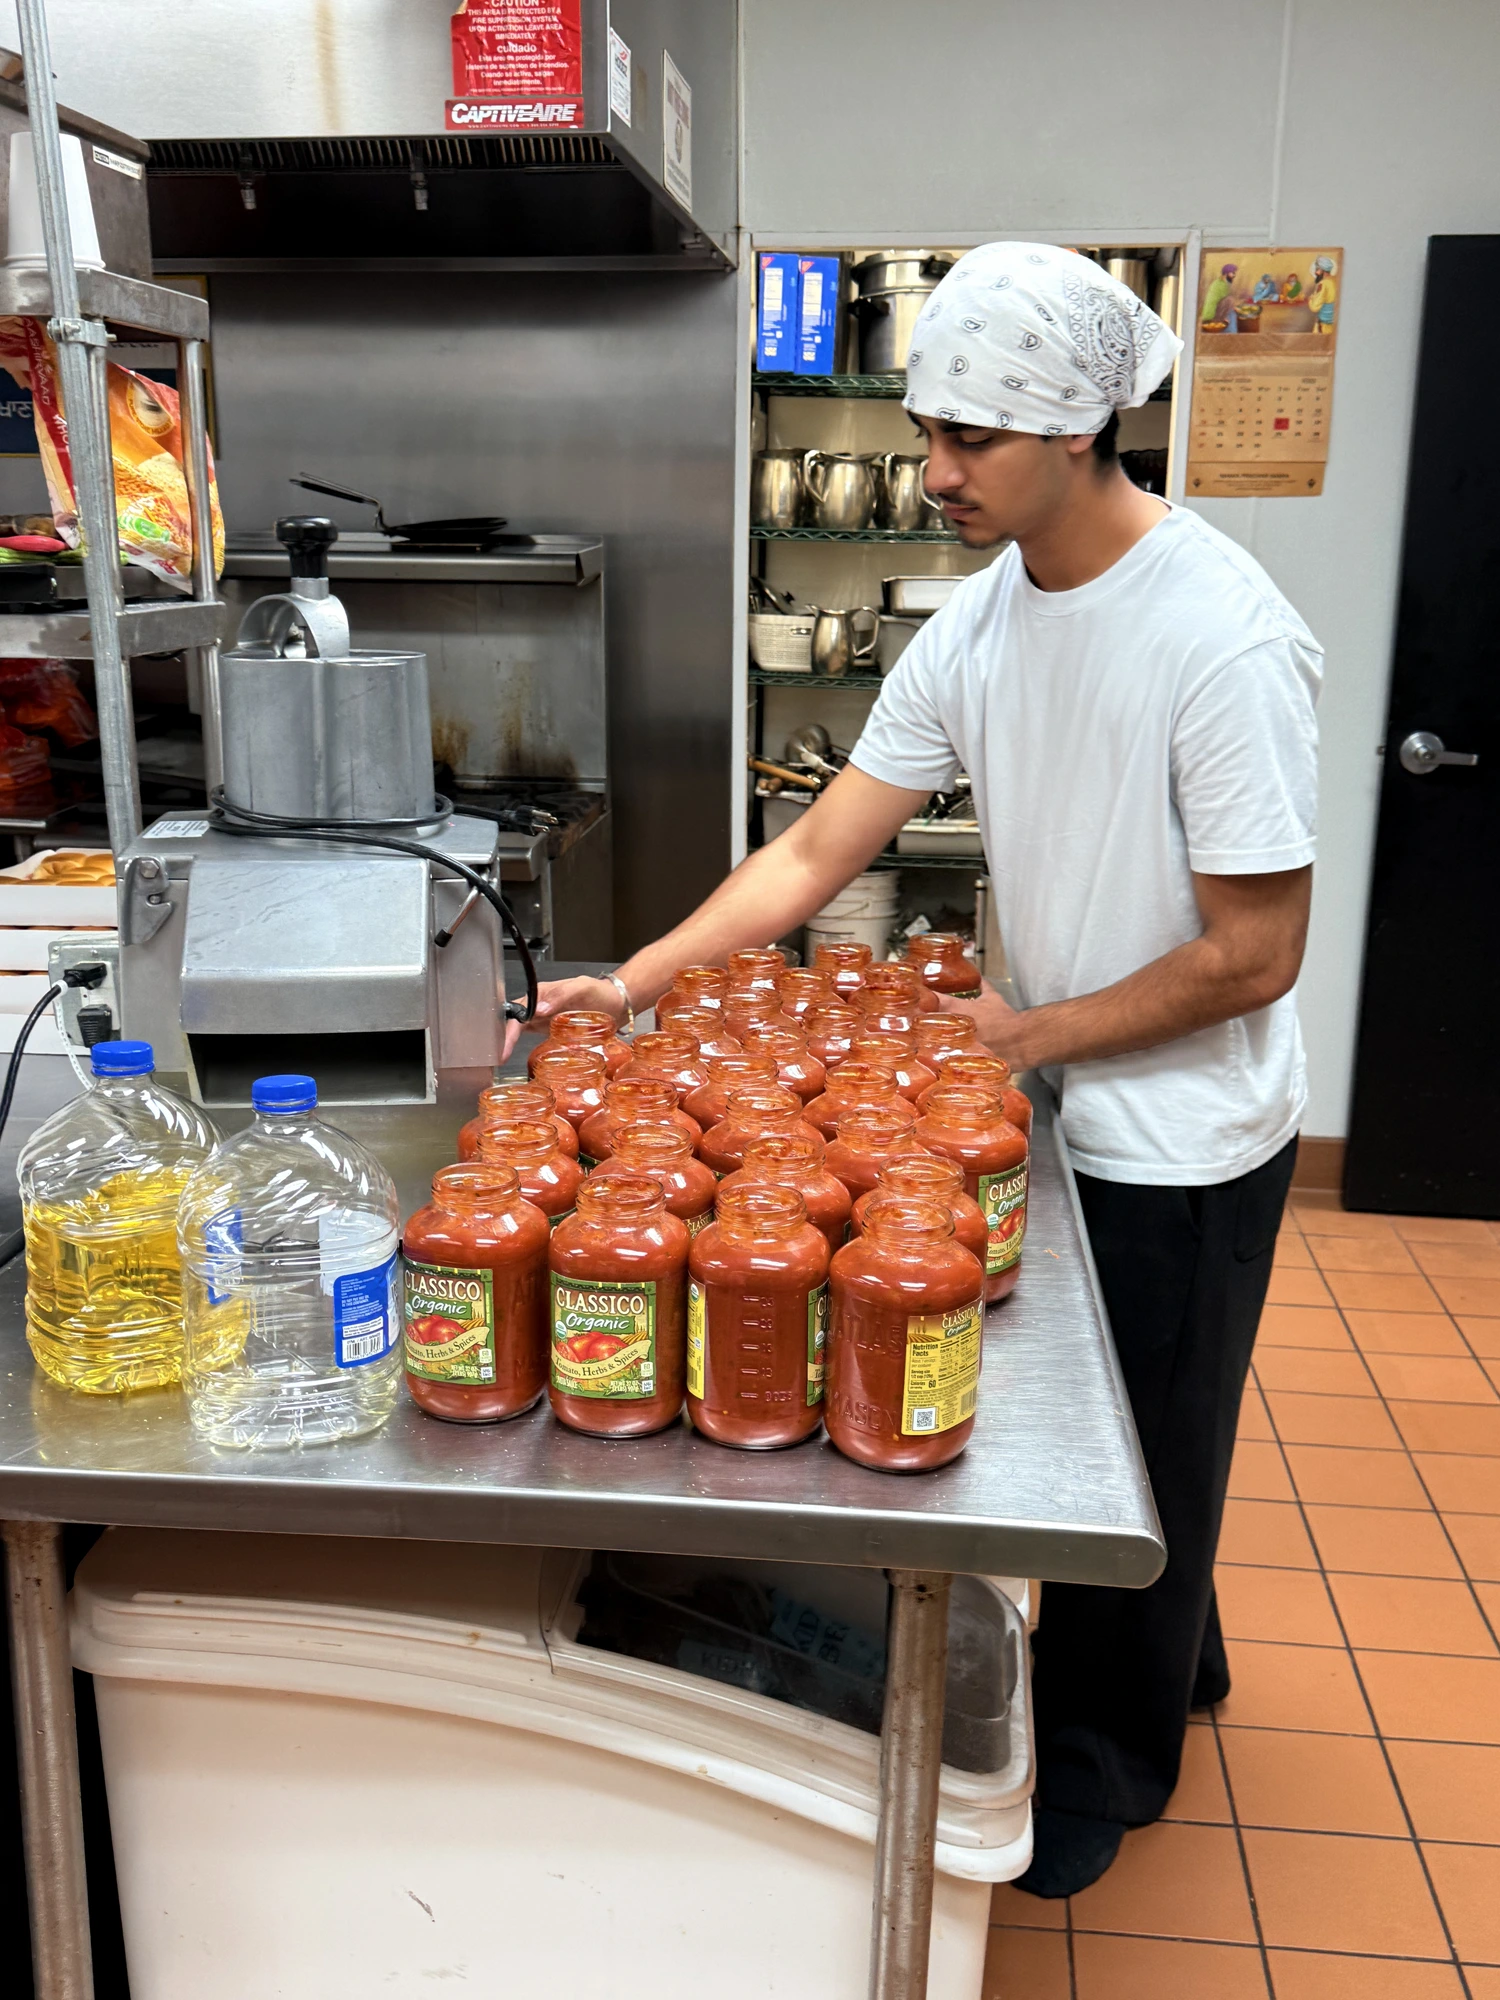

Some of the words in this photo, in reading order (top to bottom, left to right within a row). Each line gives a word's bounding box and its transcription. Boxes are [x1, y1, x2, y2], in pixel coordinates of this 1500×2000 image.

[487, 16, 531, 24] SUPPRESSION
[507, 7, 546, 15] PROTECTED
[545, 54, 556, 62] por
[988, 1171, 1028, 1201] CLASSIC
[998, 1196, 1026, 1214] Organi
[404, 1269, 481, 1302] CLASSICO
[411, 1295, 468, 1315] Organic
[556, 1287, 644, 1316] CLASSICO
[565, 1312, 630, 1331] Organic
[942, 1306, 976, 1329] CLASSICO
[425, 1348, 449, 1360] Herbs
[448, 1347, 454, 1355] &
[453, 1334, 476, 1351] Spices
[912, 1343, 939, 1351] Nutrition
[555, 1355, 581, 1377] Tomato,
[582, 1364, 608, 1376] Herbs
[608, 1362, 615, 1370] &
[614, 1348, 639, 1366] Spices
[928, 1379, 937, 1389] 60
